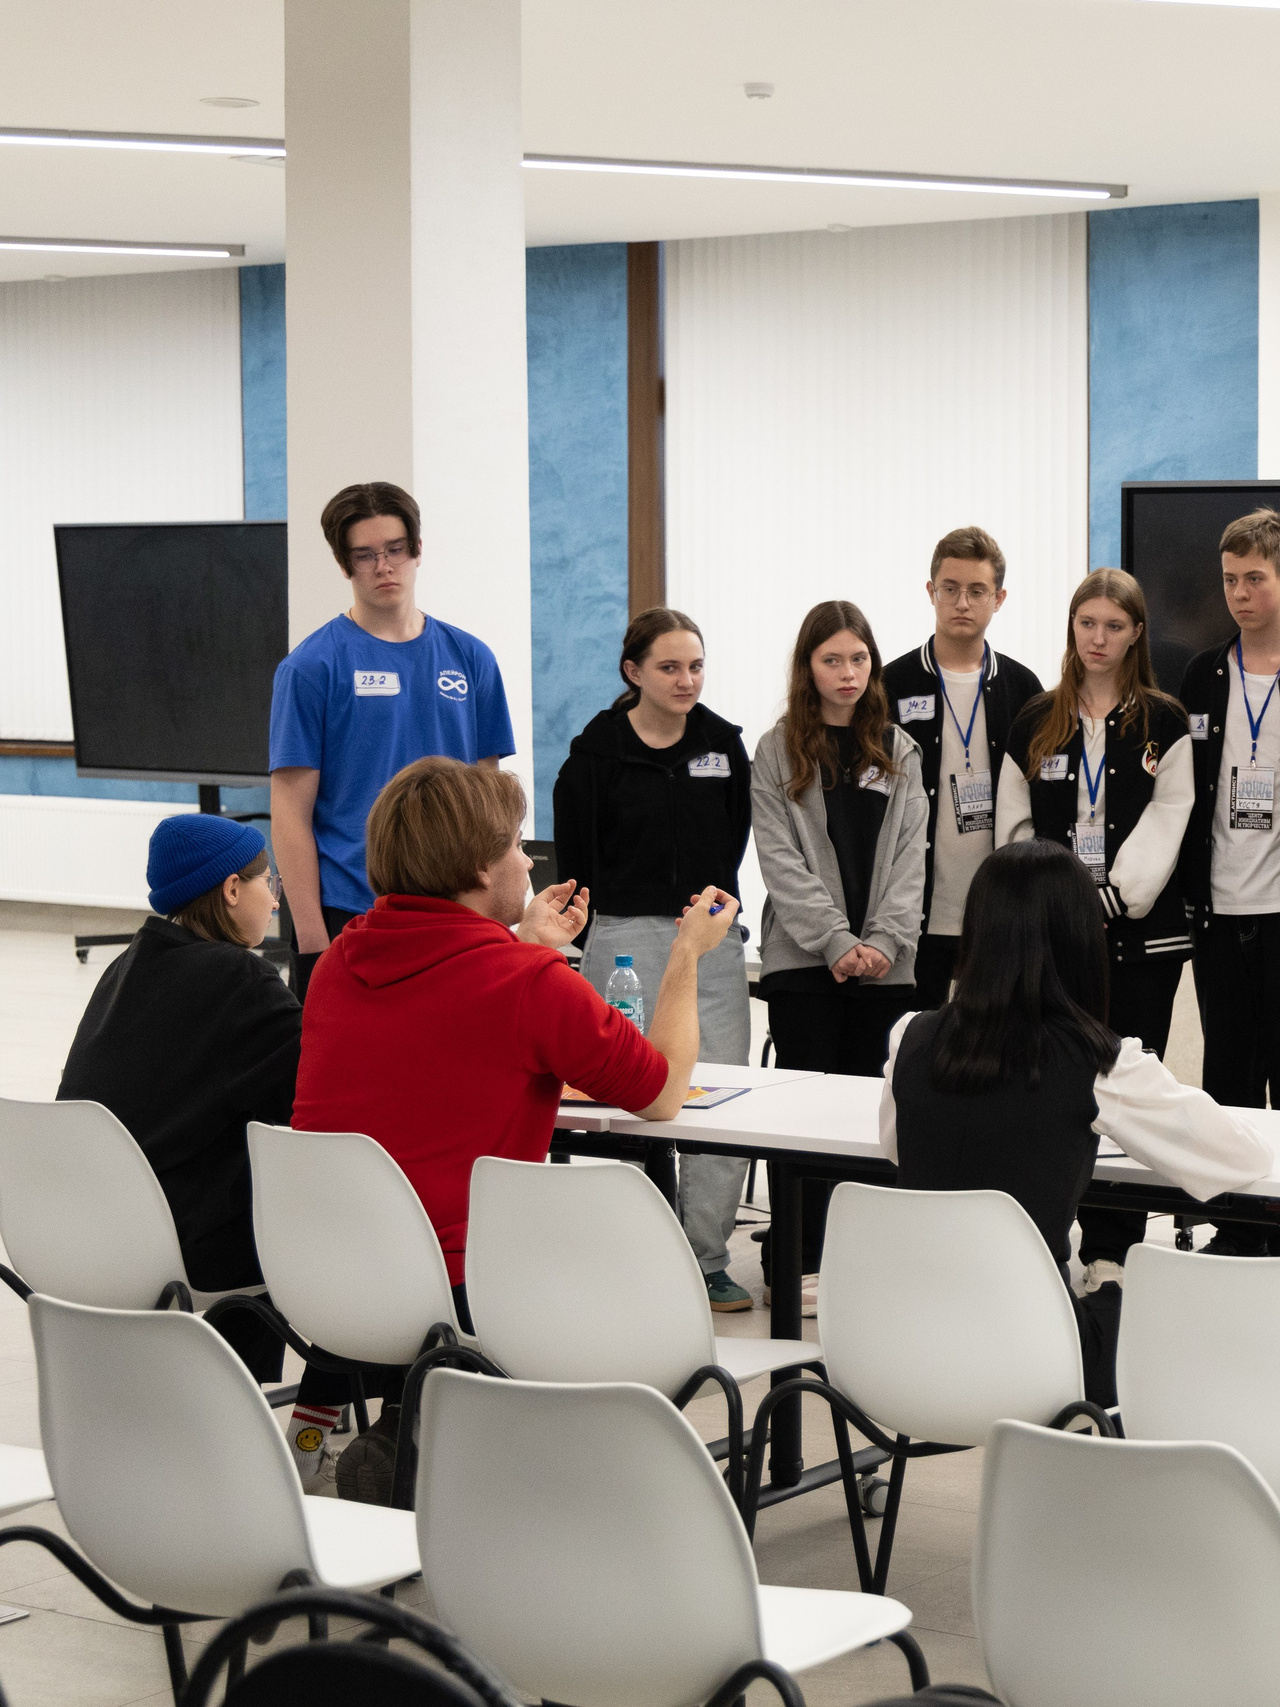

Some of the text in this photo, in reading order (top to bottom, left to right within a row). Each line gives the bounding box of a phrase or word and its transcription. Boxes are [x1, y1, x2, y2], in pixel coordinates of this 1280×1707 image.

[361, 675, 387, 686] 23.2
[440, 669, 467, 682] АПЕЙРОН
[696, 755, 721, 768] 22.2
